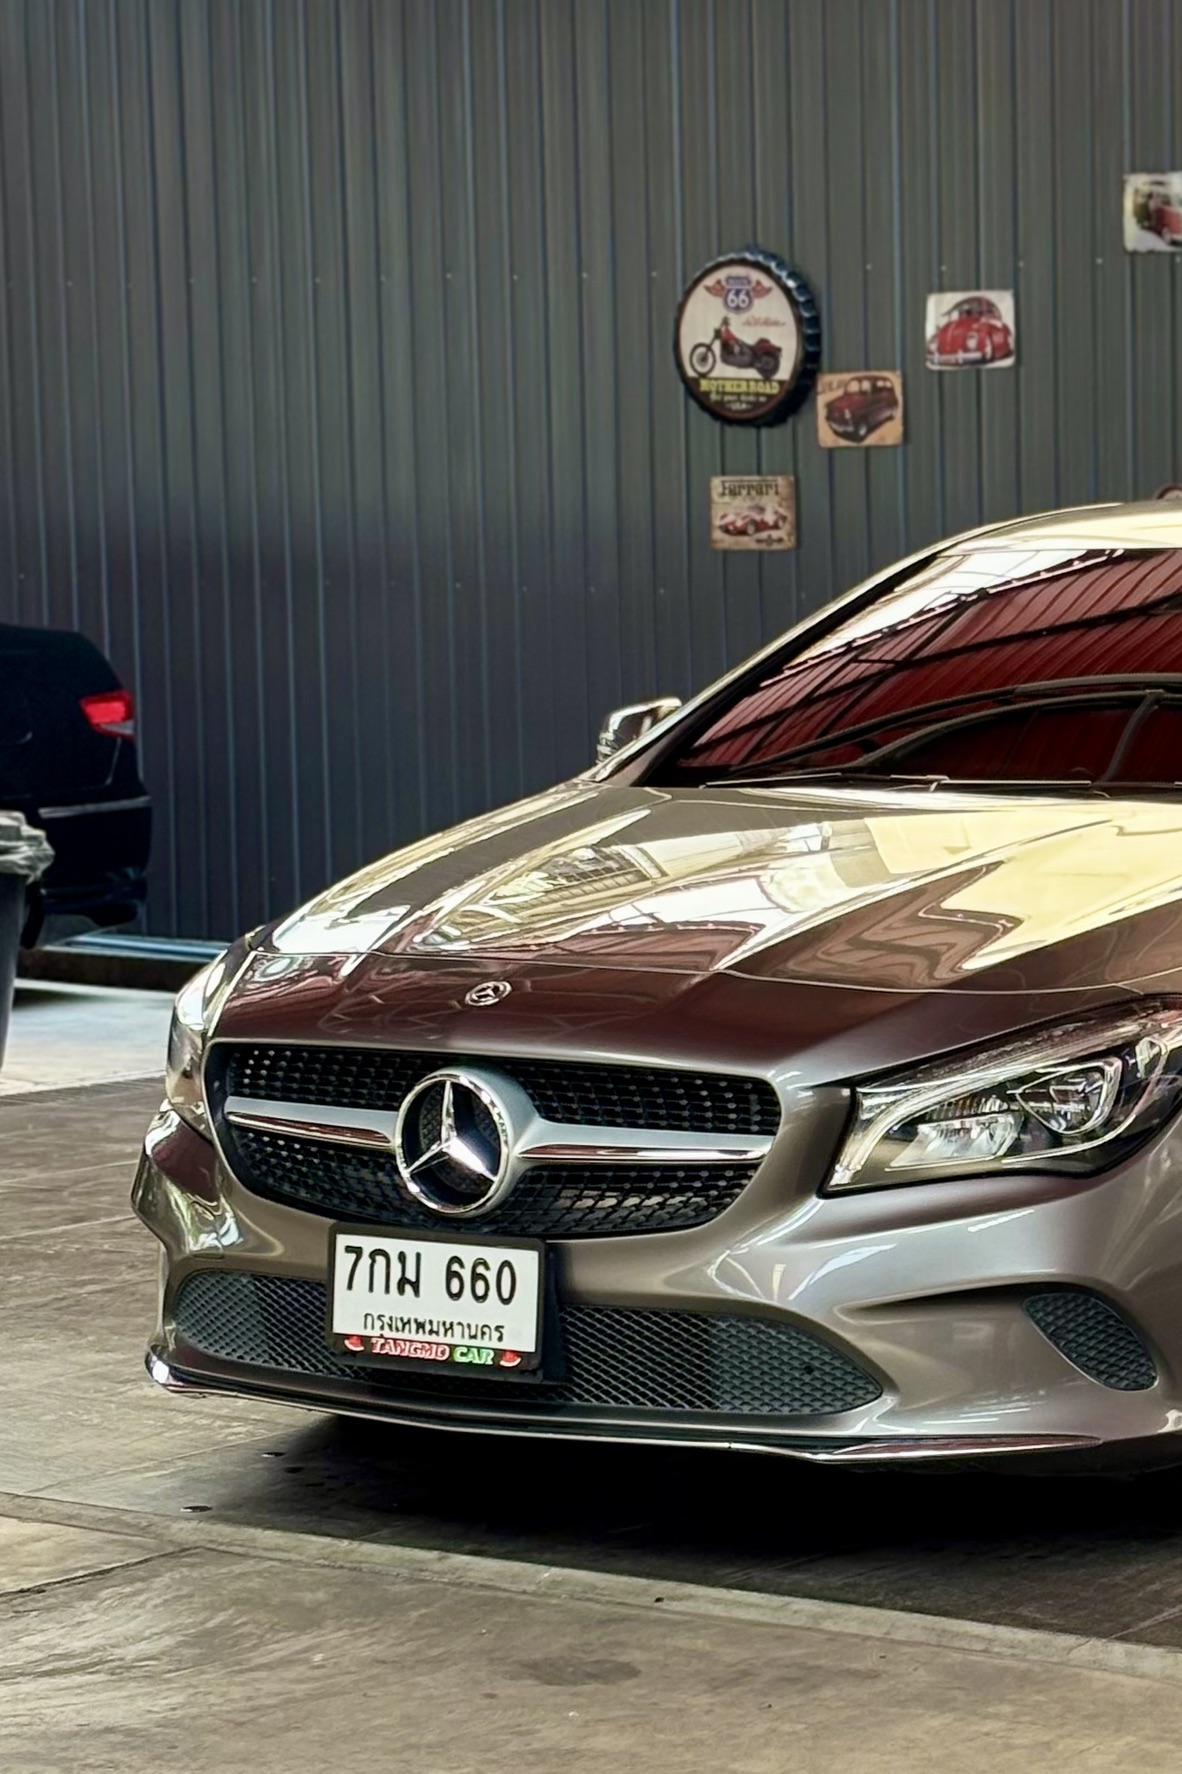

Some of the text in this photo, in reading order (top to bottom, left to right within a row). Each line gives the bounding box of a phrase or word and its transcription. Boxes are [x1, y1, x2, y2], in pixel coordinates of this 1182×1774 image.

[727, 289, 750, 308] 66
[749, 381, 779, 394] ROAD
[344, 1245, 517, 1305] 7กม 660
[370, 1337, 495, 1365] TANGMO CAR
